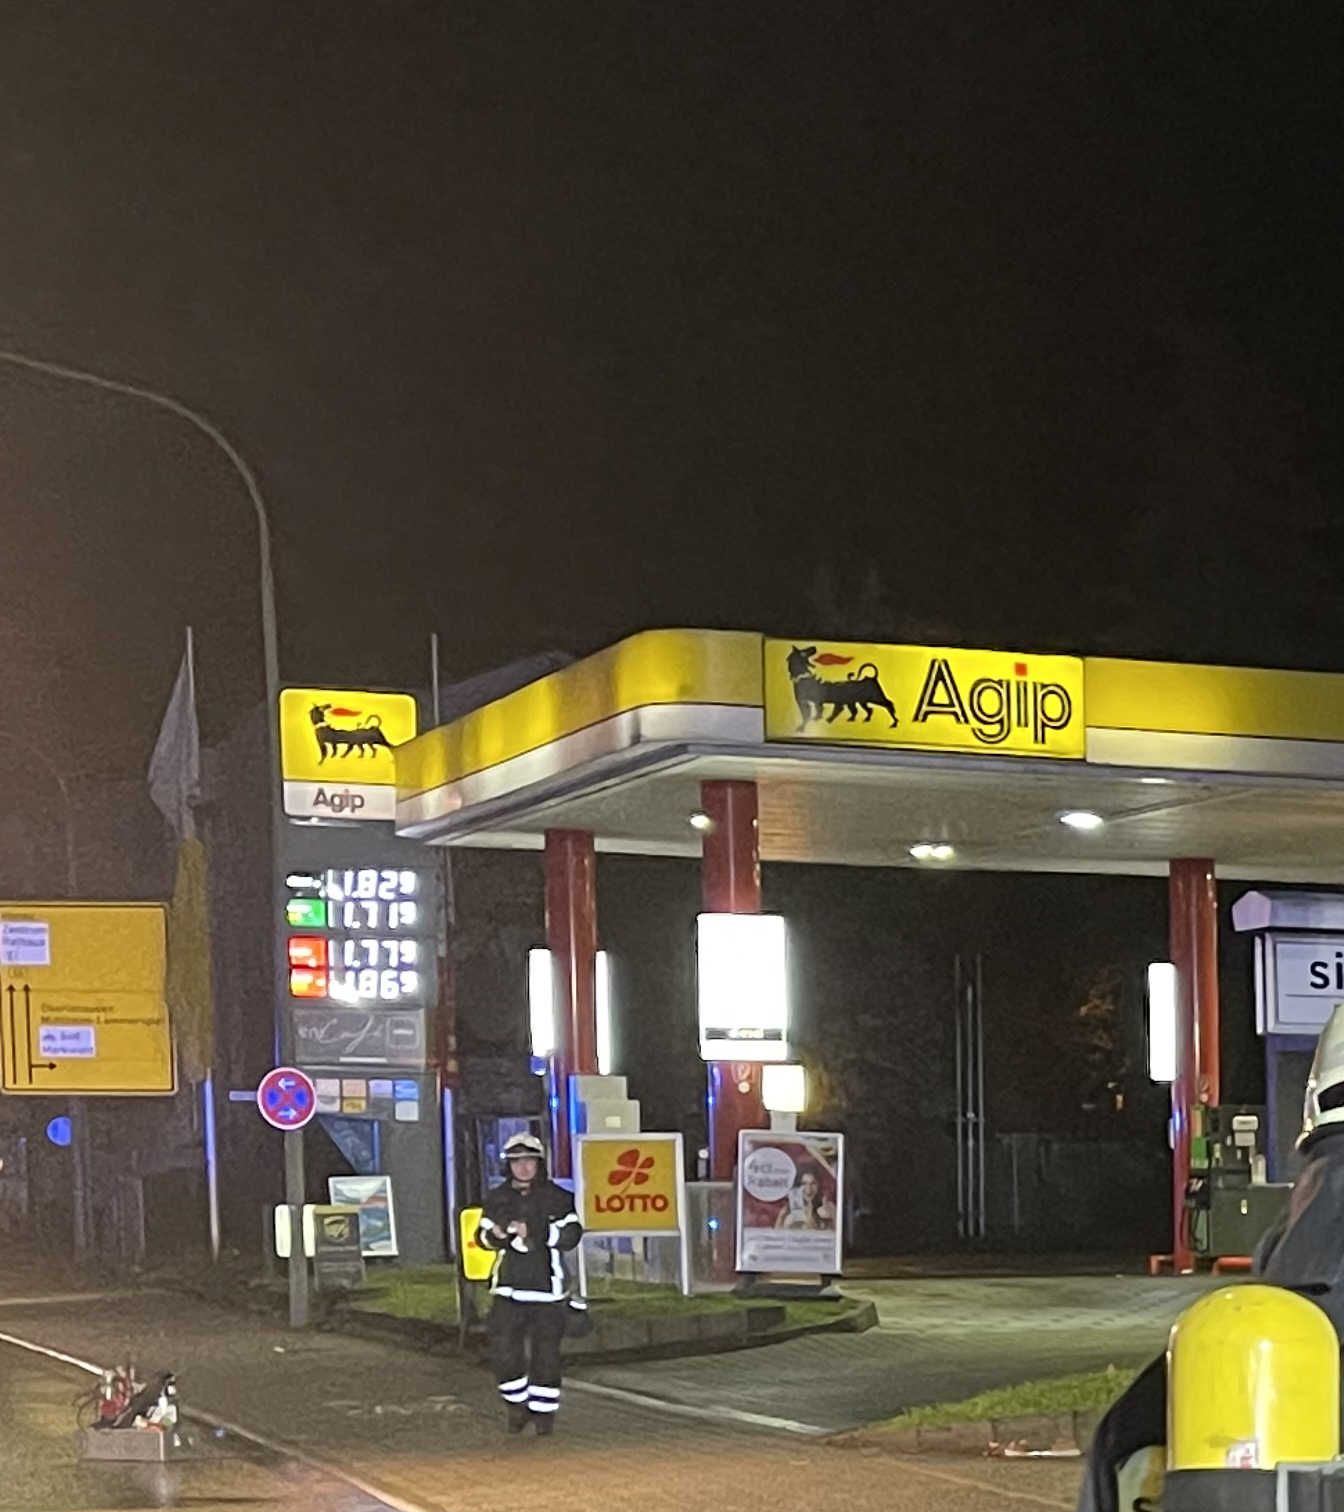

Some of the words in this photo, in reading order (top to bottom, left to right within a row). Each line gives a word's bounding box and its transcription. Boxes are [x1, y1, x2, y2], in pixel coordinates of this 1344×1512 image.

[912, 658, 1072, 745] Agip
[312, 787, 366, 814] Agip
[594, 1193, 669, 1214] LOTTO
